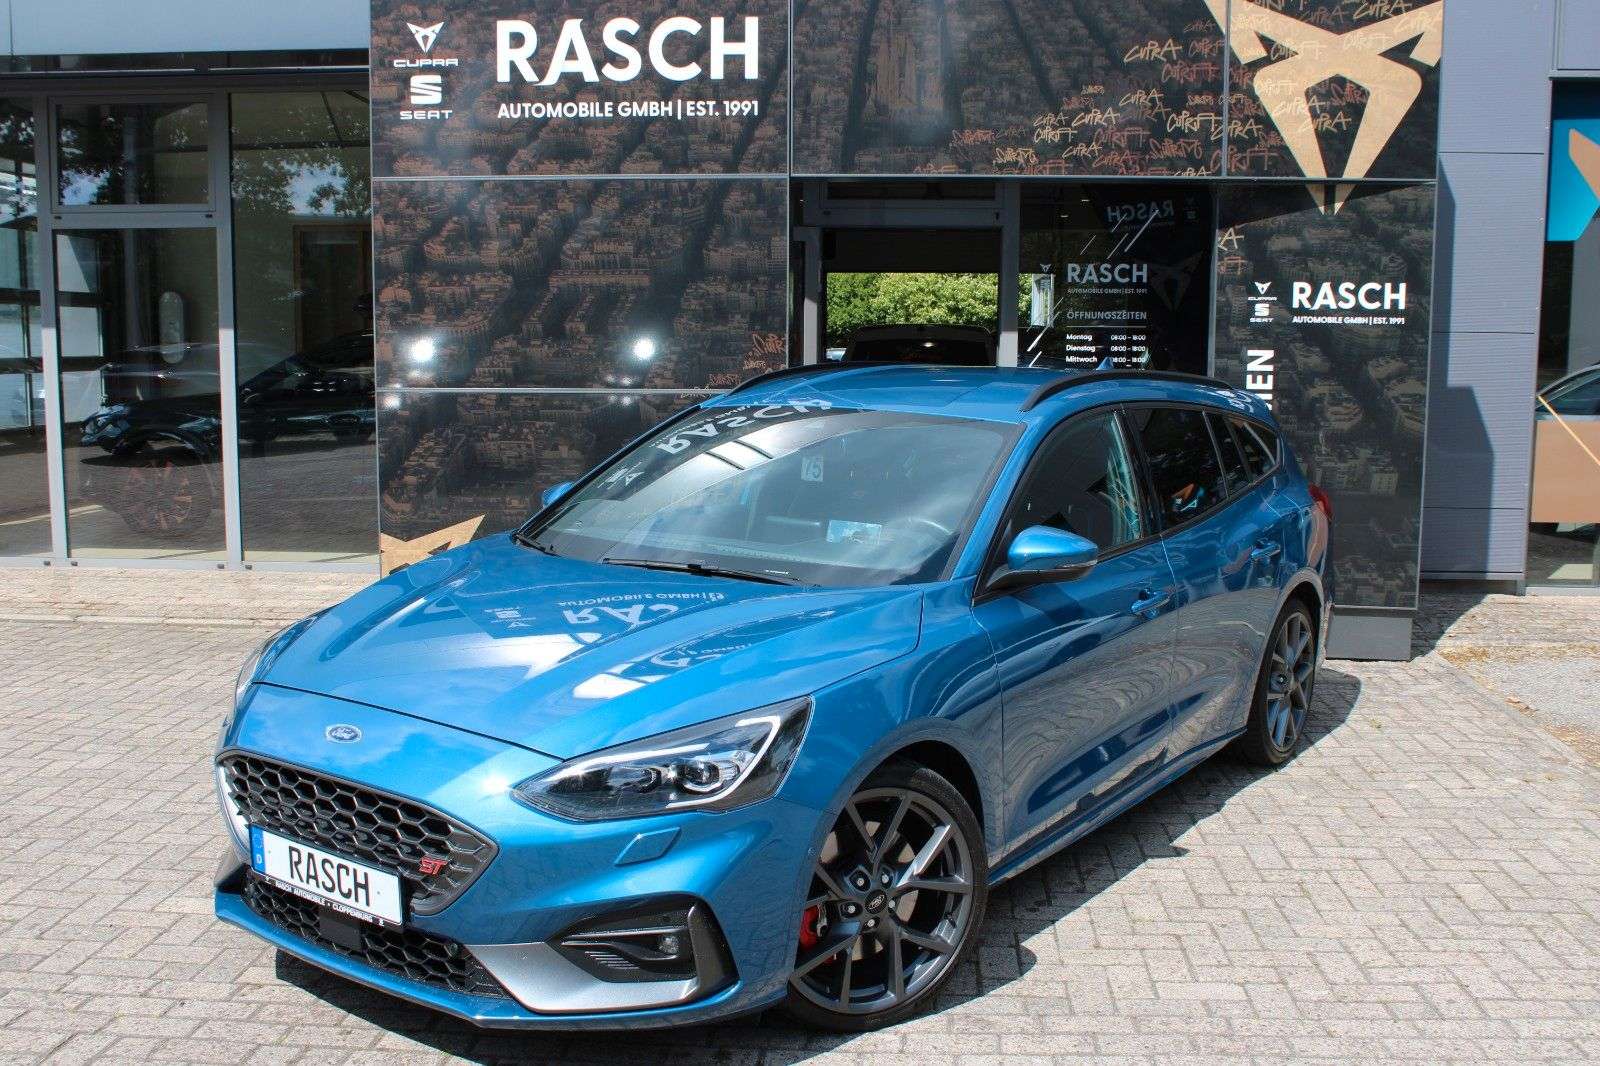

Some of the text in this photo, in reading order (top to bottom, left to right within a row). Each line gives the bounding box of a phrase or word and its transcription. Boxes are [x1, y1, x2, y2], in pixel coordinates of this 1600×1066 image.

[496, 16, 760, 86] RASCH
[393, 58, 459, 68] CUPRA
[399, 109, 453, 120] SEAT
[497, 100, 759, 119] AUTOMOBILE GMBH EST. 1991
[1067, 263, 1148, 284] RASCH
[1292, 281, 1407, 310] RASCH
[1066, 310, 1147, 320] ÖFFNUNGSZEITEN
[1292, 316, 1343, 324] AUTOMOBILE
[1344, 317, 1369, 325] GMBH
[1389, 317, 1405, 325] 1991
[1066, 333, 1093, 342] Montag
[1066, 345, 1096, 353] Dienstag
[1065, 355, 1098, 363] Mittwoch
[256, 853, 263, 864] D
[417, 855, 448, 876] ST
[289, 845, 370, 907] RASCH
